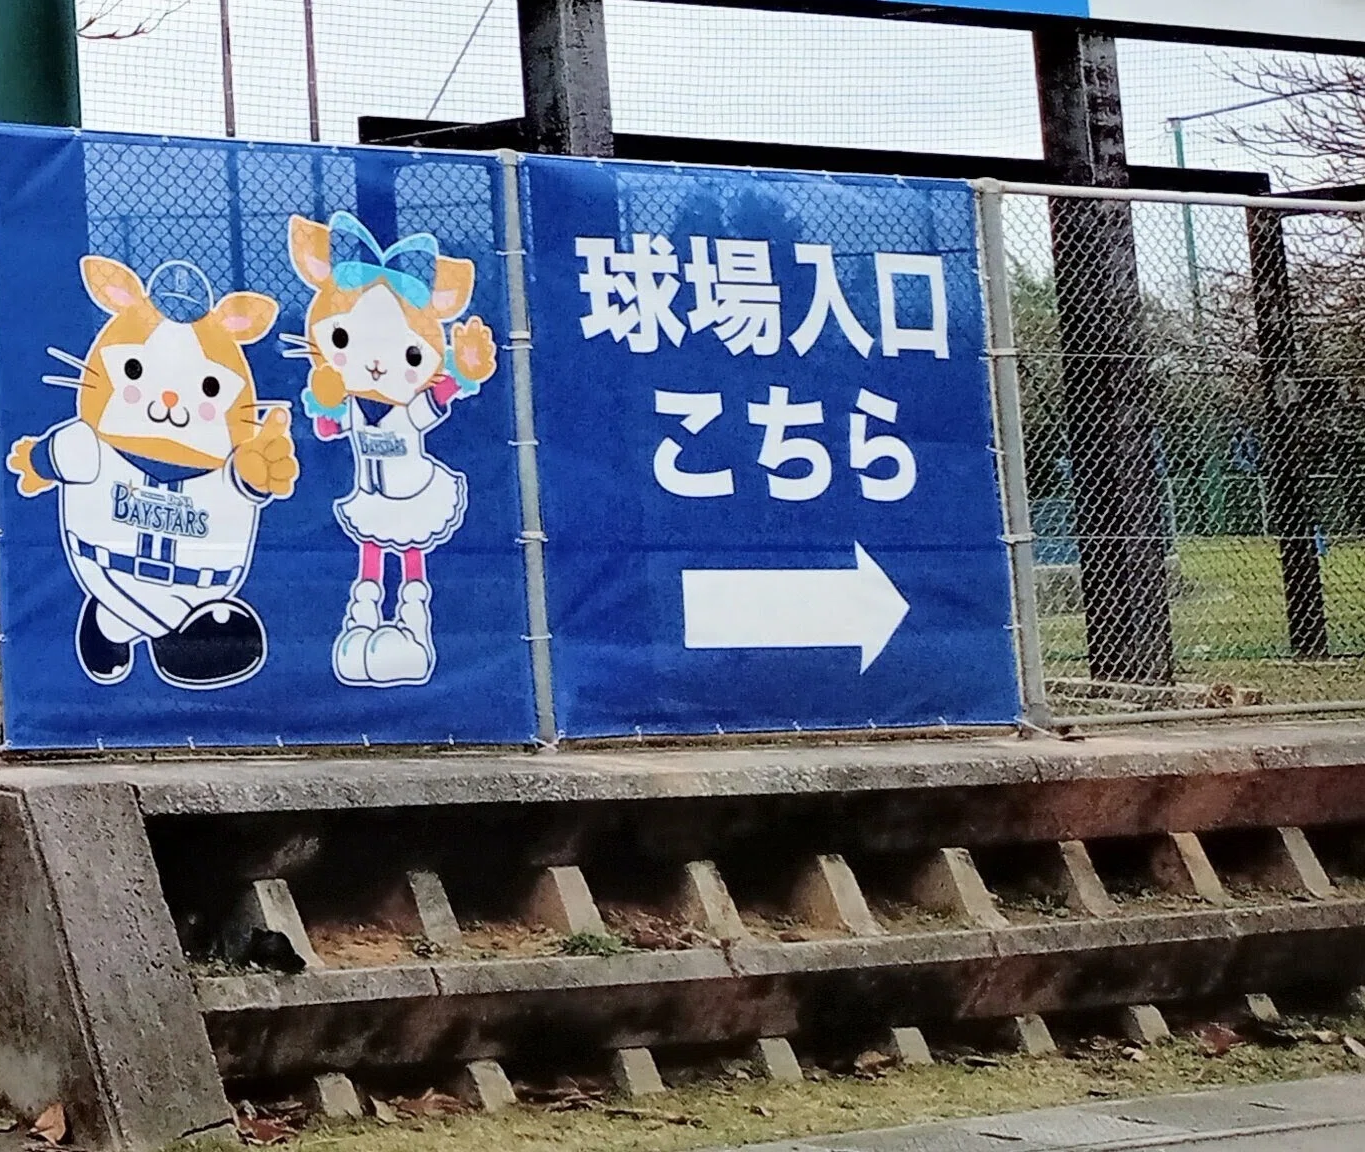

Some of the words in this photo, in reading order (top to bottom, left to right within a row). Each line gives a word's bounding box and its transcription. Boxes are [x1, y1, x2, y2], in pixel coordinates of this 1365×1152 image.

[574, 234, 950, 360] 球場入口
[653, 385, 918, 503] こちら
[111, 481, 209, 538] BAYSTARS
